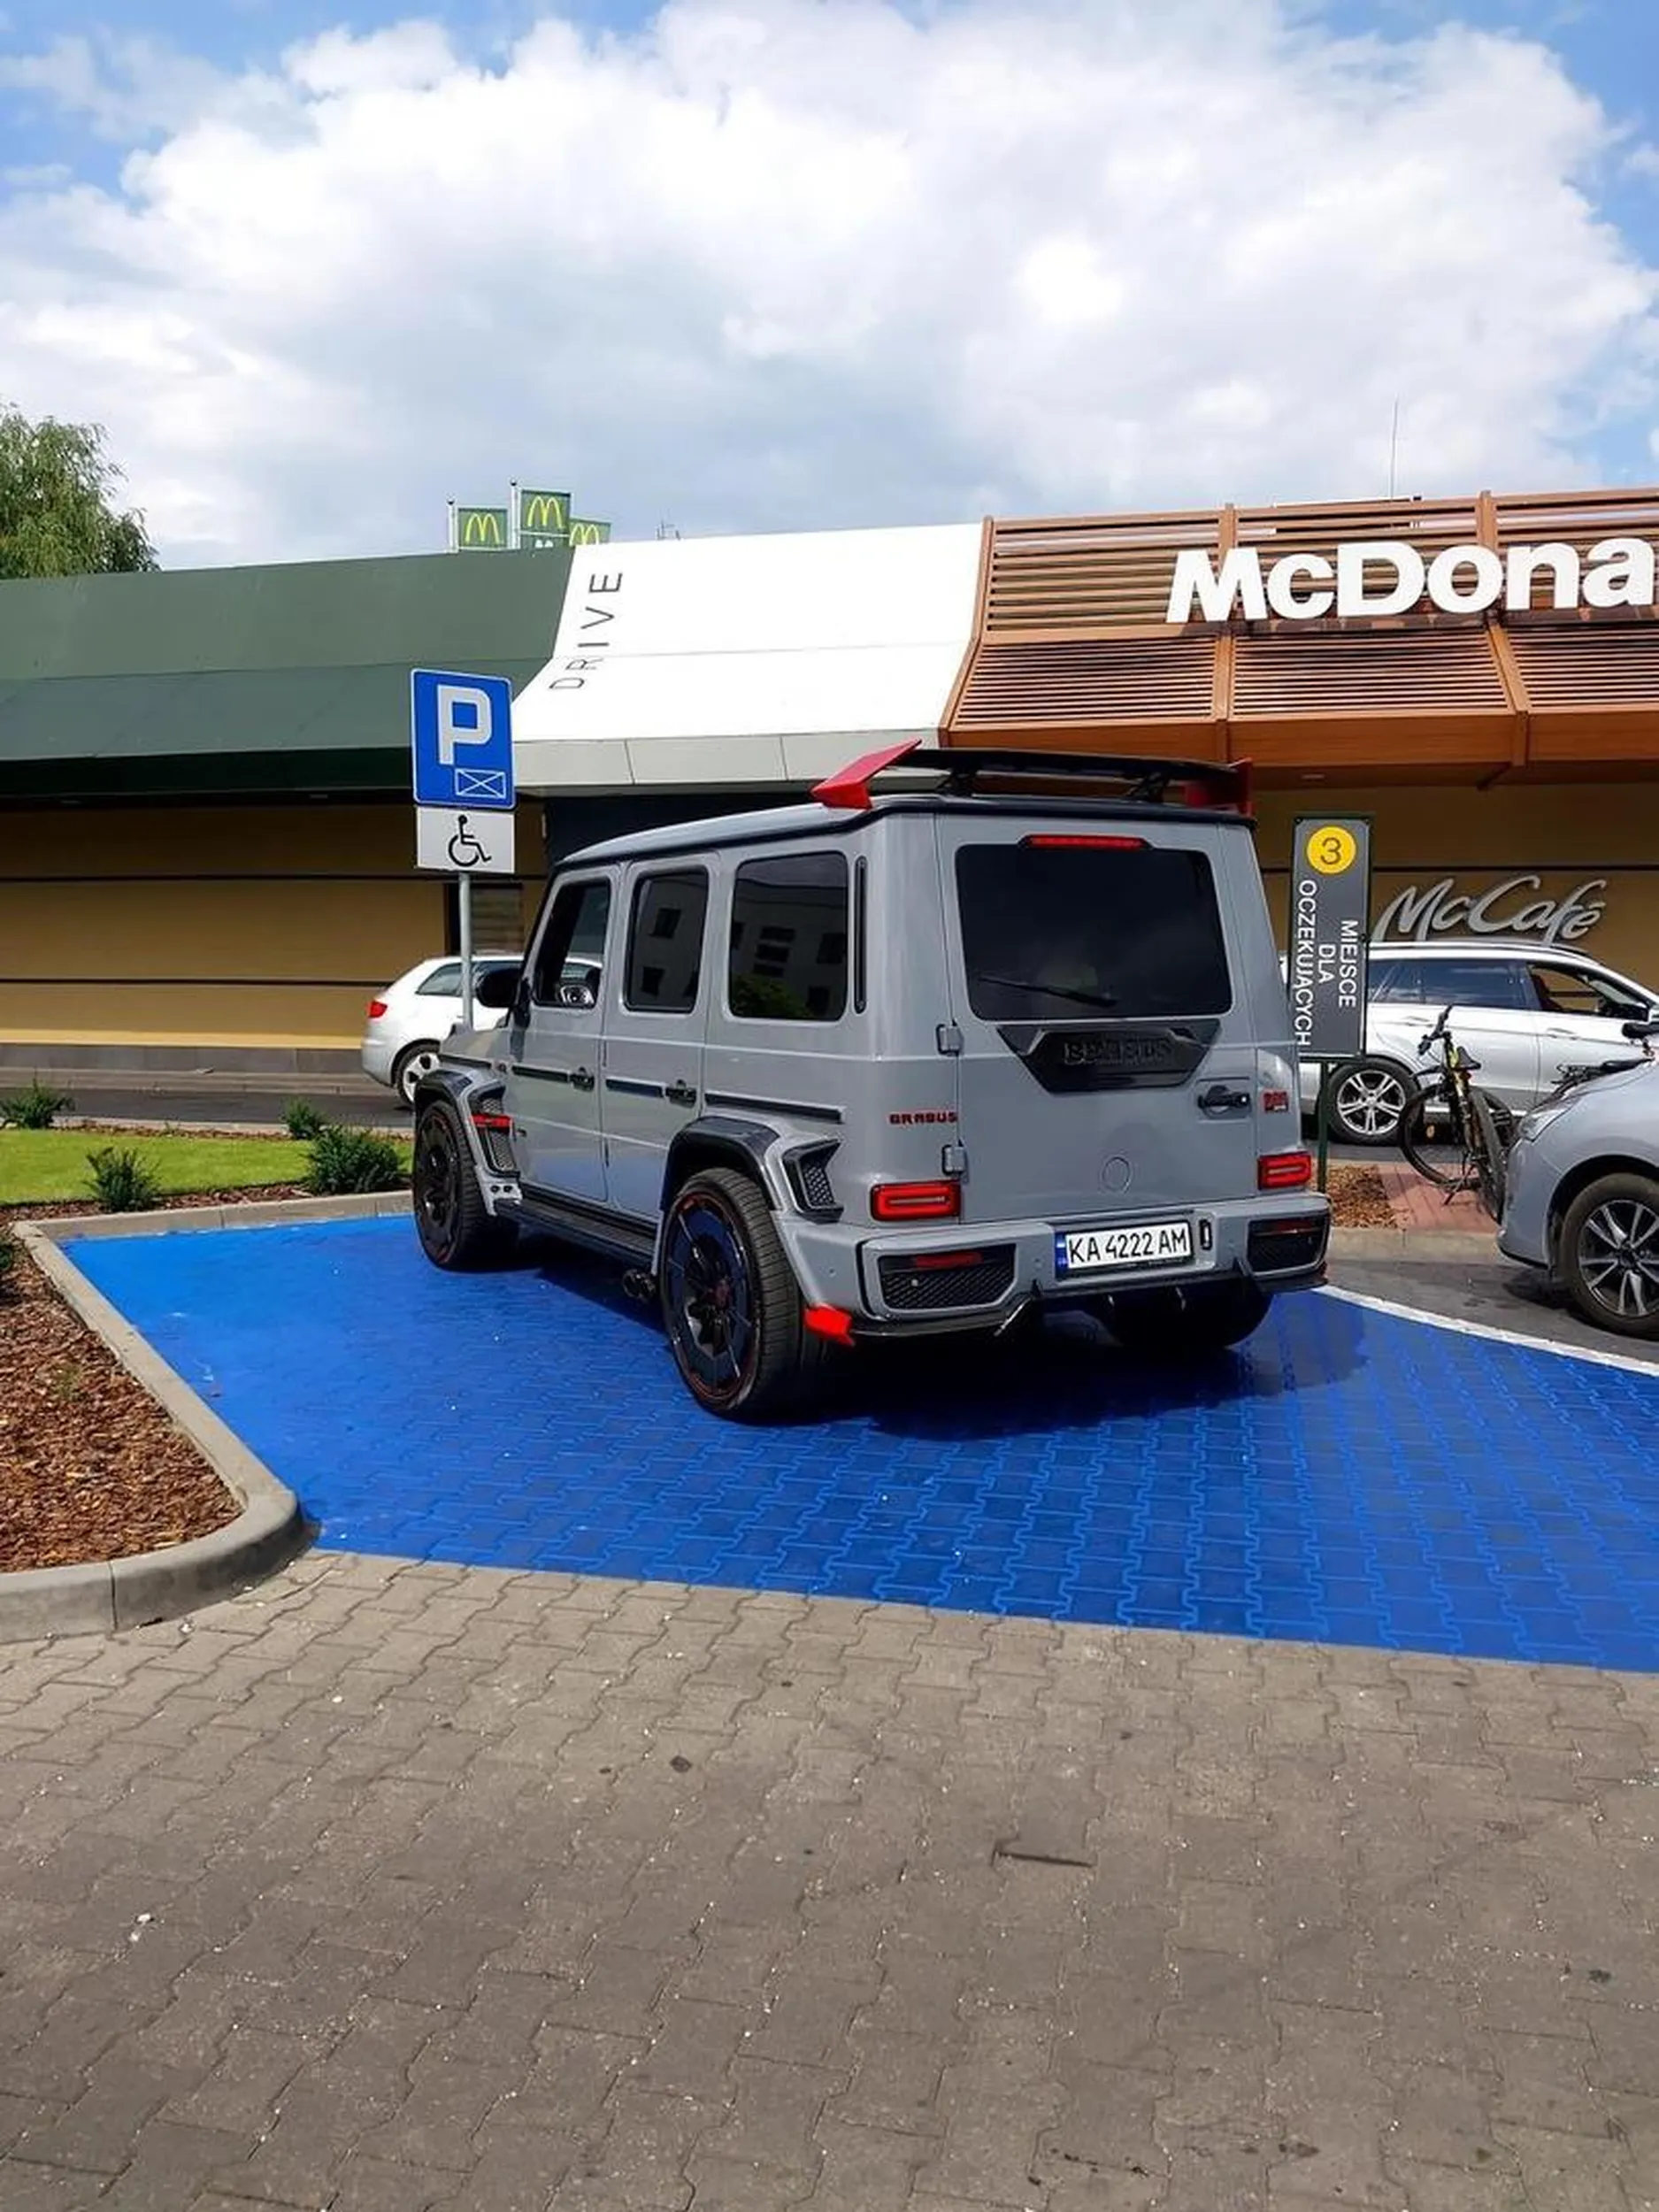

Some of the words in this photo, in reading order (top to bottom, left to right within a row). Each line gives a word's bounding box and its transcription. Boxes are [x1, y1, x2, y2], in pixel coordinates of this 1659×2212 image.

[1166, 537, 1655, 622] McDona
[549, 572, 623, 689] DRIVE
[436, 684, 492, 765] P
[1320, 836, 1342, 865] 3
[1372, 874, 1607, 947] McCafé
[1293, 879, 1317, 1046] OCZEKUJĄCYCH
[1317, 943, 1337, 984] DLA
[1338, 919, 1359, 1008] MIEJSCE
[888, 1110, 958, 1125] BRABUS
[1069, 1236, 1101, 1263] KA
[1105, 1232, 1155, 1259] 4222
[1157, 1228, 1187, 1255] AM
